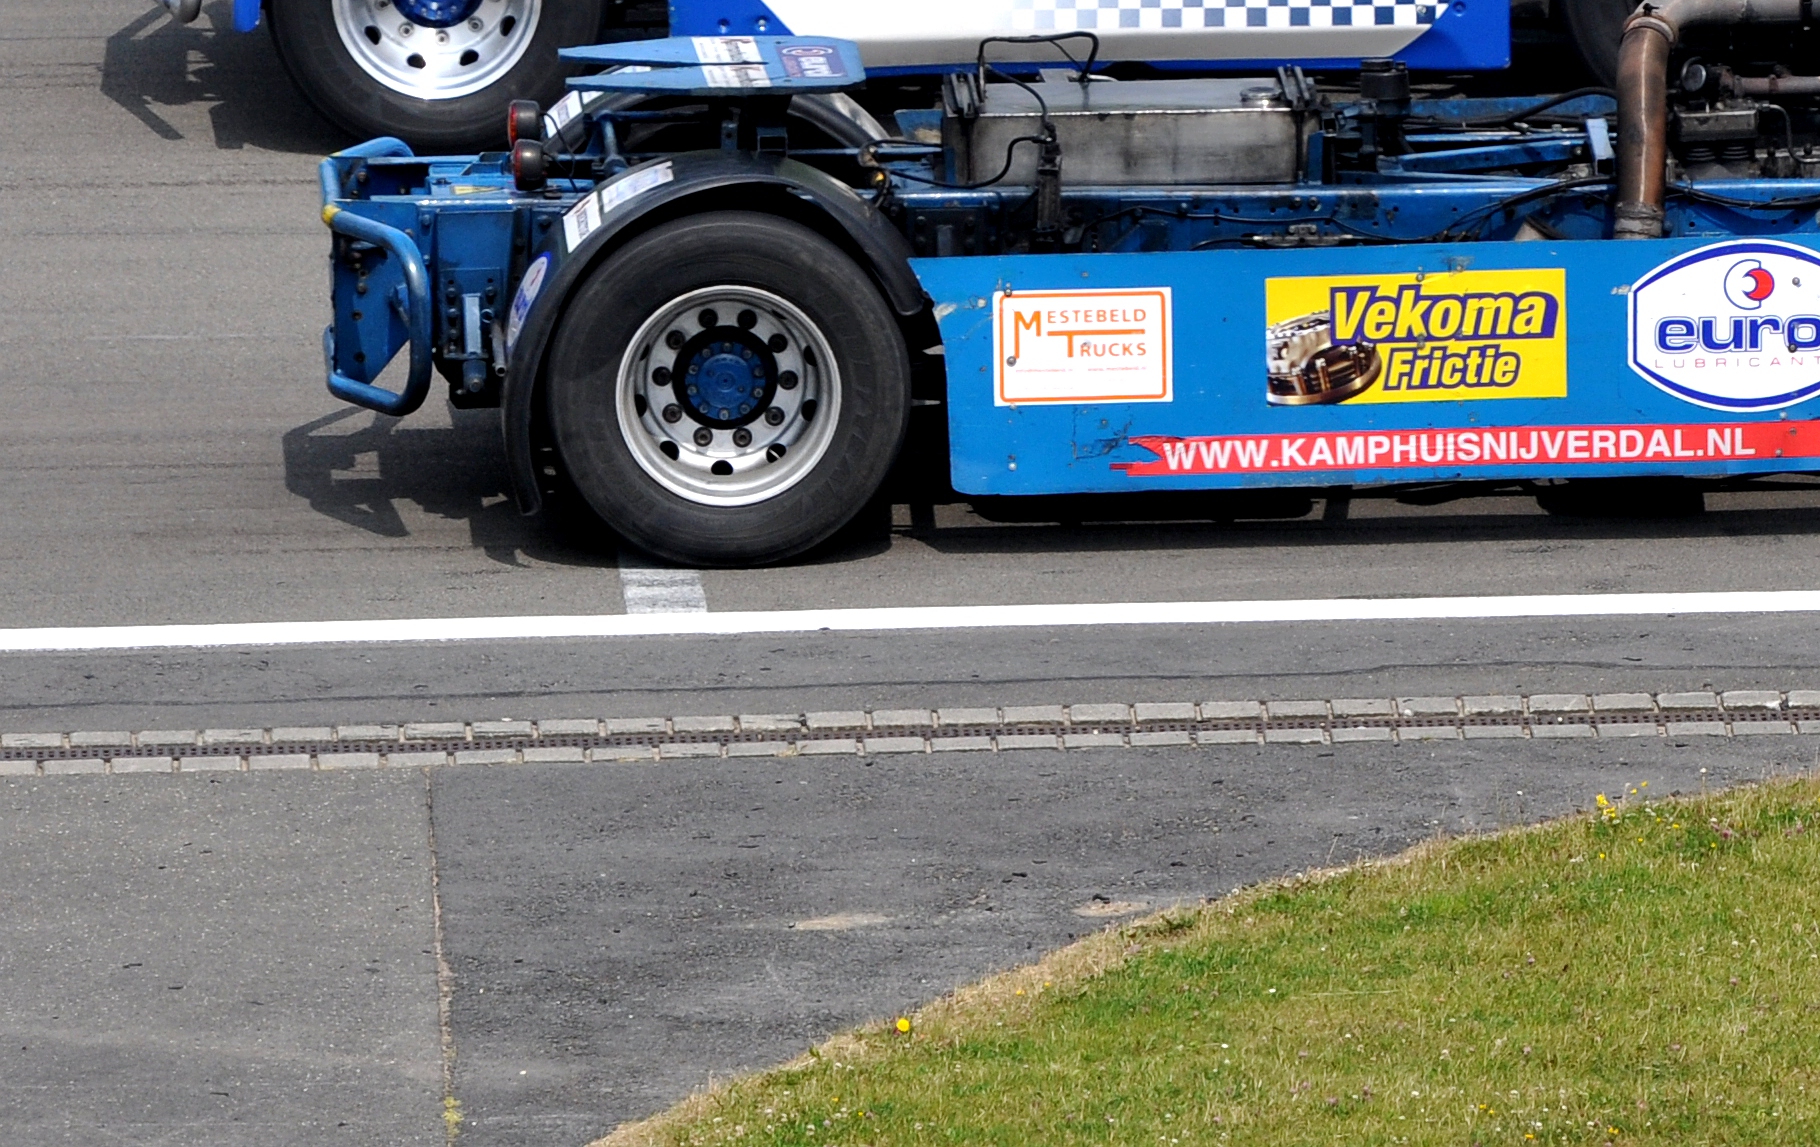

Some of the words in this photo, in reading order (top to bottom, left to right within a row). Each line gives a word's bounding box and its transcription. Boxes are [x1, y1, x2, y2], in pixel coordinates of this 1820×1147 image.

[1013, 309, 1146, 346] MESTEBELD
[1331, 287, 1553, 342] Vekoma
[1047, 329, 1147, 358] TRUCKS
[1385, 347, 1520, 390] Frictie
[1163, 427, 1757, 471] WWW.KAMPHUISNIJVERDAL.NL
